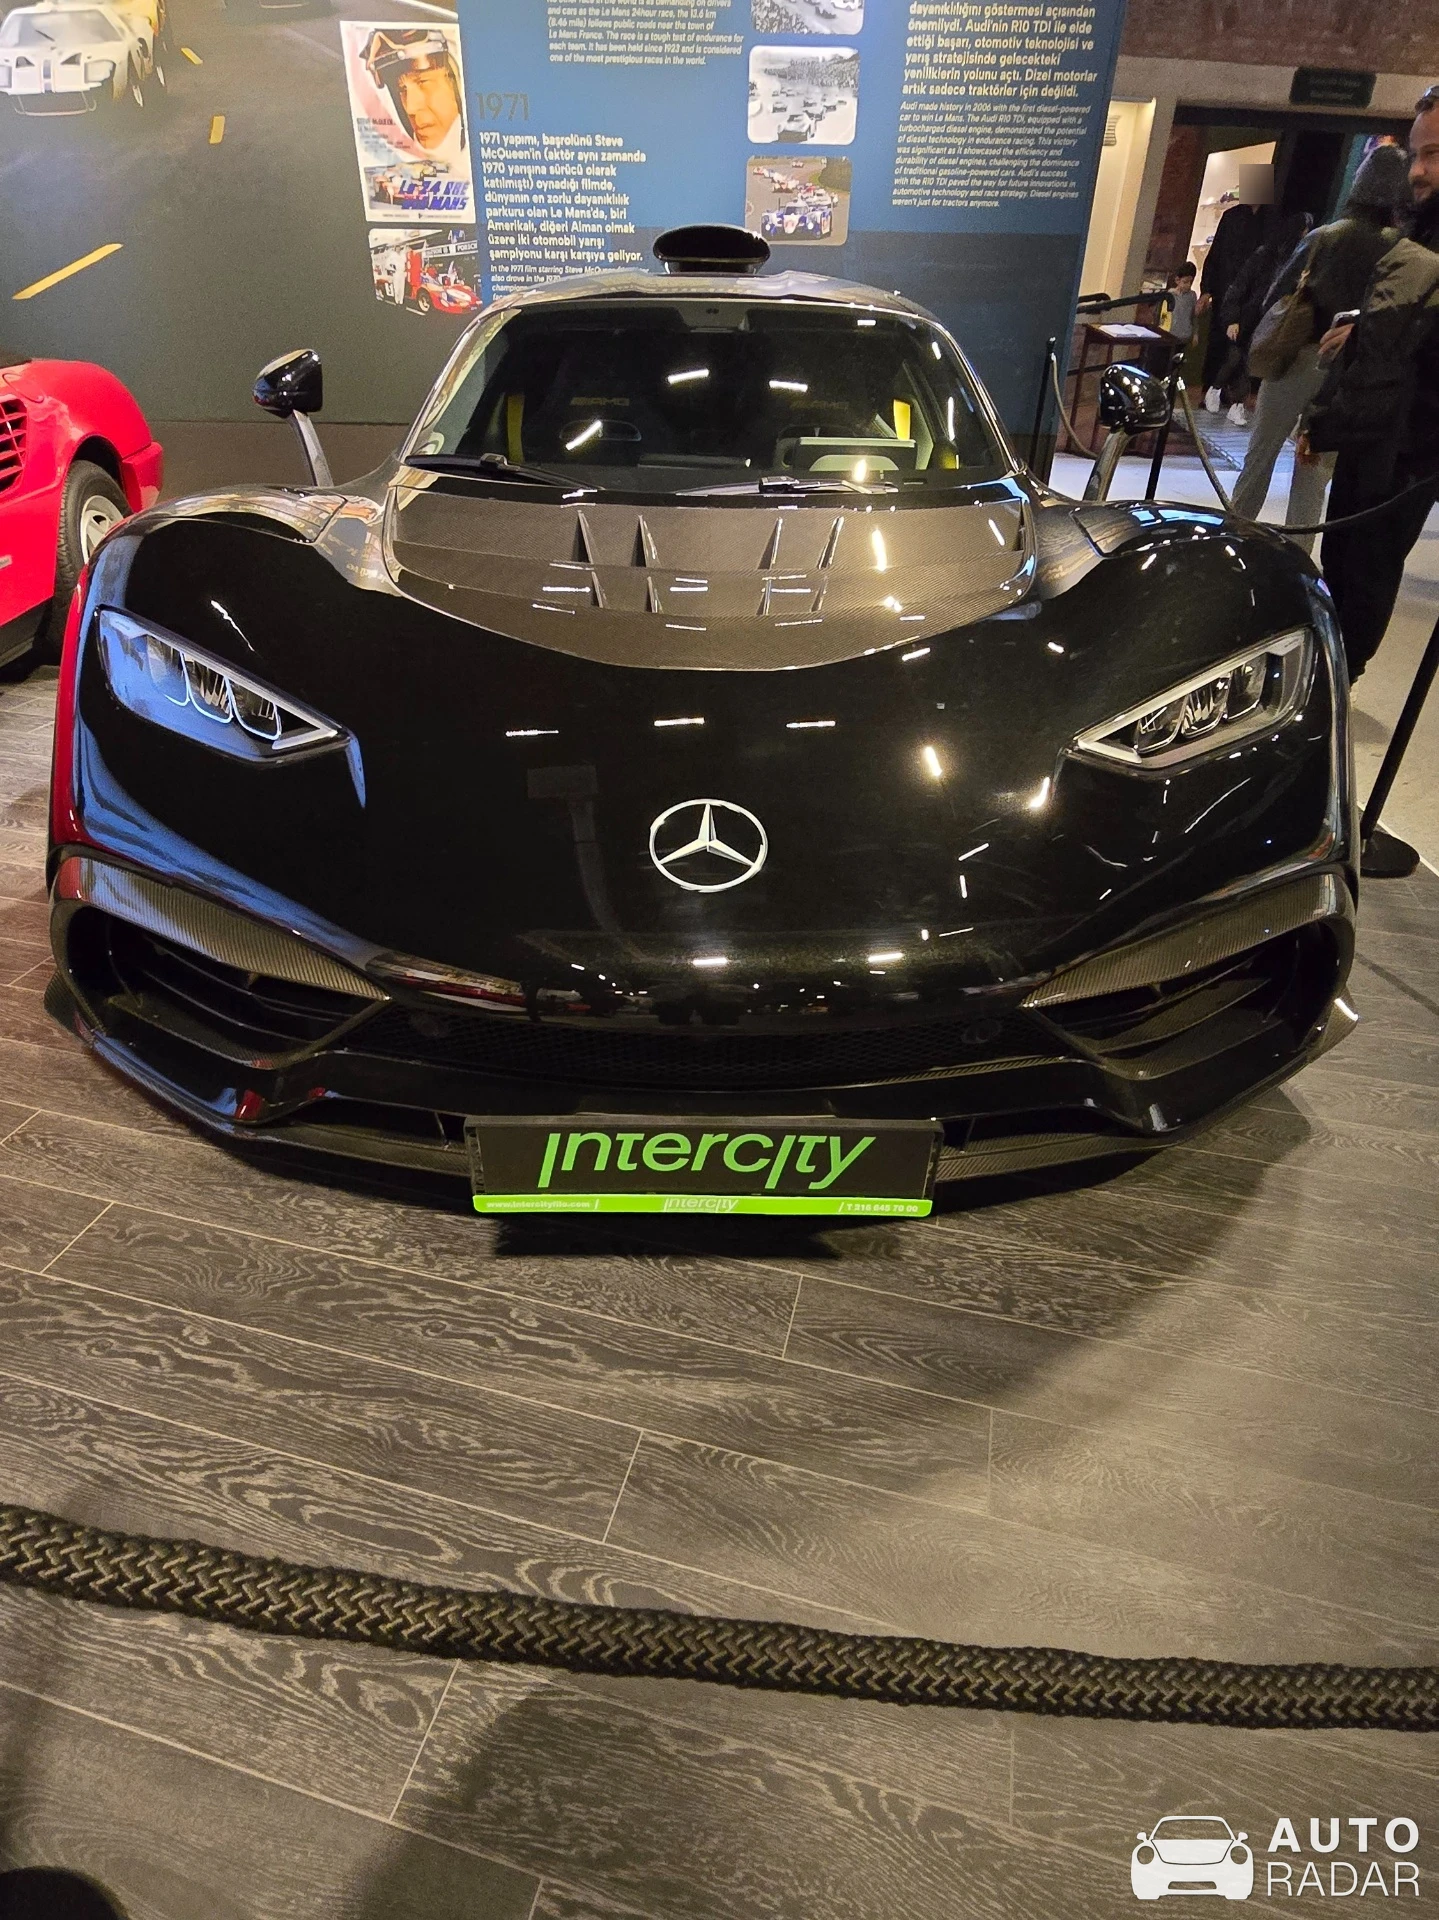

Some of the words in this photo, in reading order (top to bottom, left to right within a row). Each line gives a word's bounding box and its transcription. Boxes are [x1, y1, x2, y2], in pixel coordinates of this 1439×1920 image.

[984, 4, 1043, 20] göstermesi
[1046, 5, 1095, 20] açısından
[909, 19, 962, 35] önemliydi.
[965, 20, 1008, 32] Audi'nin
[1010, 20, 1029, 33] R10
[1032, 21, 1051, 33] TDI
[1053, 21, 1066, 33] ile
[1069, 22, 1092, 34] elde
[907, 34, 934, 50] ettiği
[937, 35, 971, 51] başarı,
[974, 36, 1022, 49] otomotiv
[1024, 37, 1078, 53] teknolojisi
[1081, 41, 1093, 50] ve
[906, 54, 930, 66] yarış
[933, 51, 996, 67] stratejisinde
[999, 52, 1060, 68] gelecekteki
[963, 68, 997, 83] yolunu
[1000, 68, 1022, 84] açtı.
[1025, 69, 1051, 81] Dizel
[1053, 69, 1098, 82] motorlar
[903, 83, 926, 95] artık
[929, 83, 965, 95] sadece
[968, 84, 1017, 96] traktörler
[1019, 84, 1038, 99] için
[1041, 85, 1078, 100] değildi.
[474, 92, 530, 121] 1971
[480, 133, 500, 145] 1971
[503, 136, 539, 148] yapımı,
[542, 134, 592, 149] başrolünü
[595, 134, 623, 146] Steve
[481, 148, 541, 163] McQueen'in
[544, 149, 574, 164] (aktör
[578, 152, 598, 164] aynı
[601, 150, 646, 163] zamanda
[483, 161, 505, 174] 1970
[508, 165, 546, 178] yarışına
[550, 163, 583, 176] sürücü
[586, 164, 616, 176] olarak
[484, 176, 534, 192] katılmıştı)
[536, 177, 578, 193] oynadığı
[582, 178, 616, 194] filmde,
[485, 192, 530, 206] dünyanın
[533, 195, 544, 204] en
[547, 193, 572, 204] zorlu
[486, 206, 524, 221] parkuru
[527, 207, 548, 218] olan
[551, 207, 562, 218] Le
[565, 207, 607, 222] Mans'da,
[610, 208, 626, 219] biri
[488, 220, 536, 234] Amerikalı,
[540, 221, 568, 235] diğeri
[571, 221, 602, 233] Alman
[605, 222, 634, 234] olmak
[488, 233, 516, 245] üzere
[518, 234, 530, 245] iki
[533, 234, 576, 246] otomobil
[579, 238, 604, 249] yarışı
[490, 247, 542, 262] şampiyonu
[545, 248, 568, 263] karşı
[570, 249, 605, 263] karşıya
[608, 249, 644, 264] geliyor.
